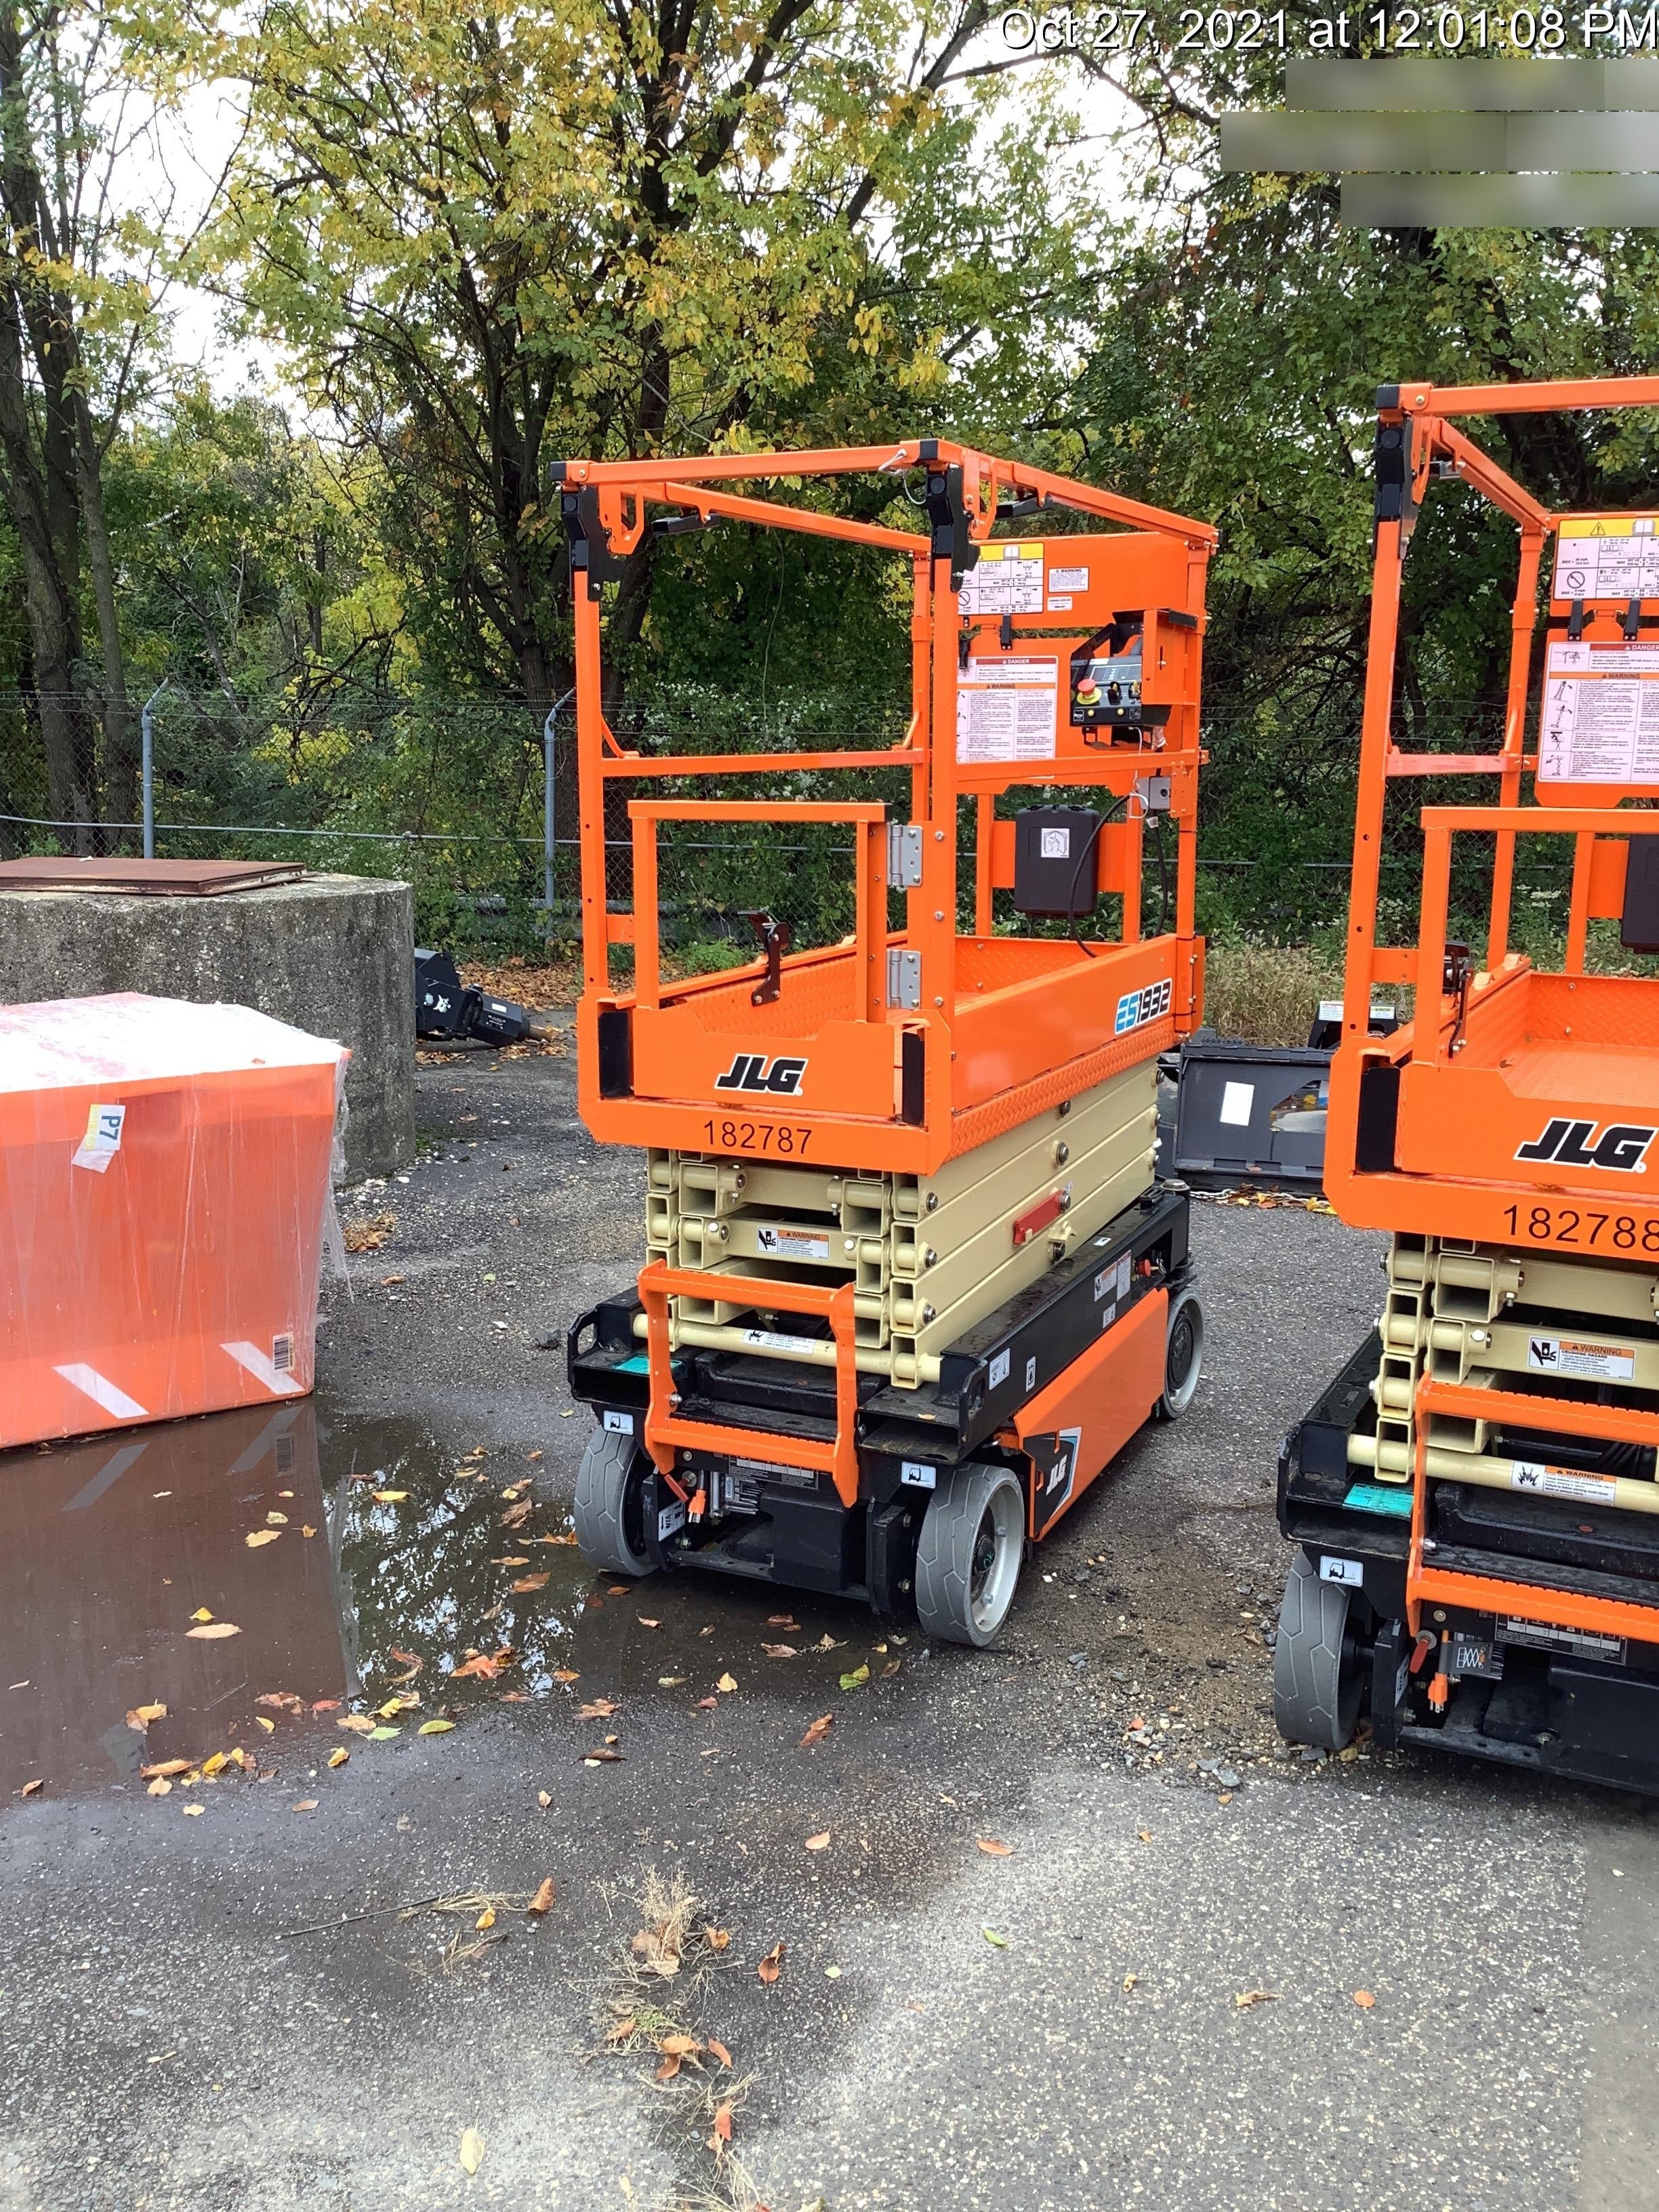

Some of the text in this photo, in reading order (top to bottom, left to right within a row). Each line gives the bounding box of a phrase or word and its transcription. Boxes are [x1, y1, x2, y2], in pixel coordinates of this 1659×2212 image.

[1115, 979, 1172, 1033] ES1932
[715, 1054, 807, 1094] JLG
[99, 1115, 122, 1141] P7
[704, 1120, 813, 1154] 182787
[1514, 1118, 1658, 1172] JLG
[792, 1232, 821, 1240] WARNING
[1504, 1204, 1659, 1252] 182788
[1580, 1344, 1622, 1355] WARNING
[1046, 1454, 1068, 1496] JLG
[1566, 1471, 1603, 1480] WARNING
[983, 1551, 995, 1569] OK
